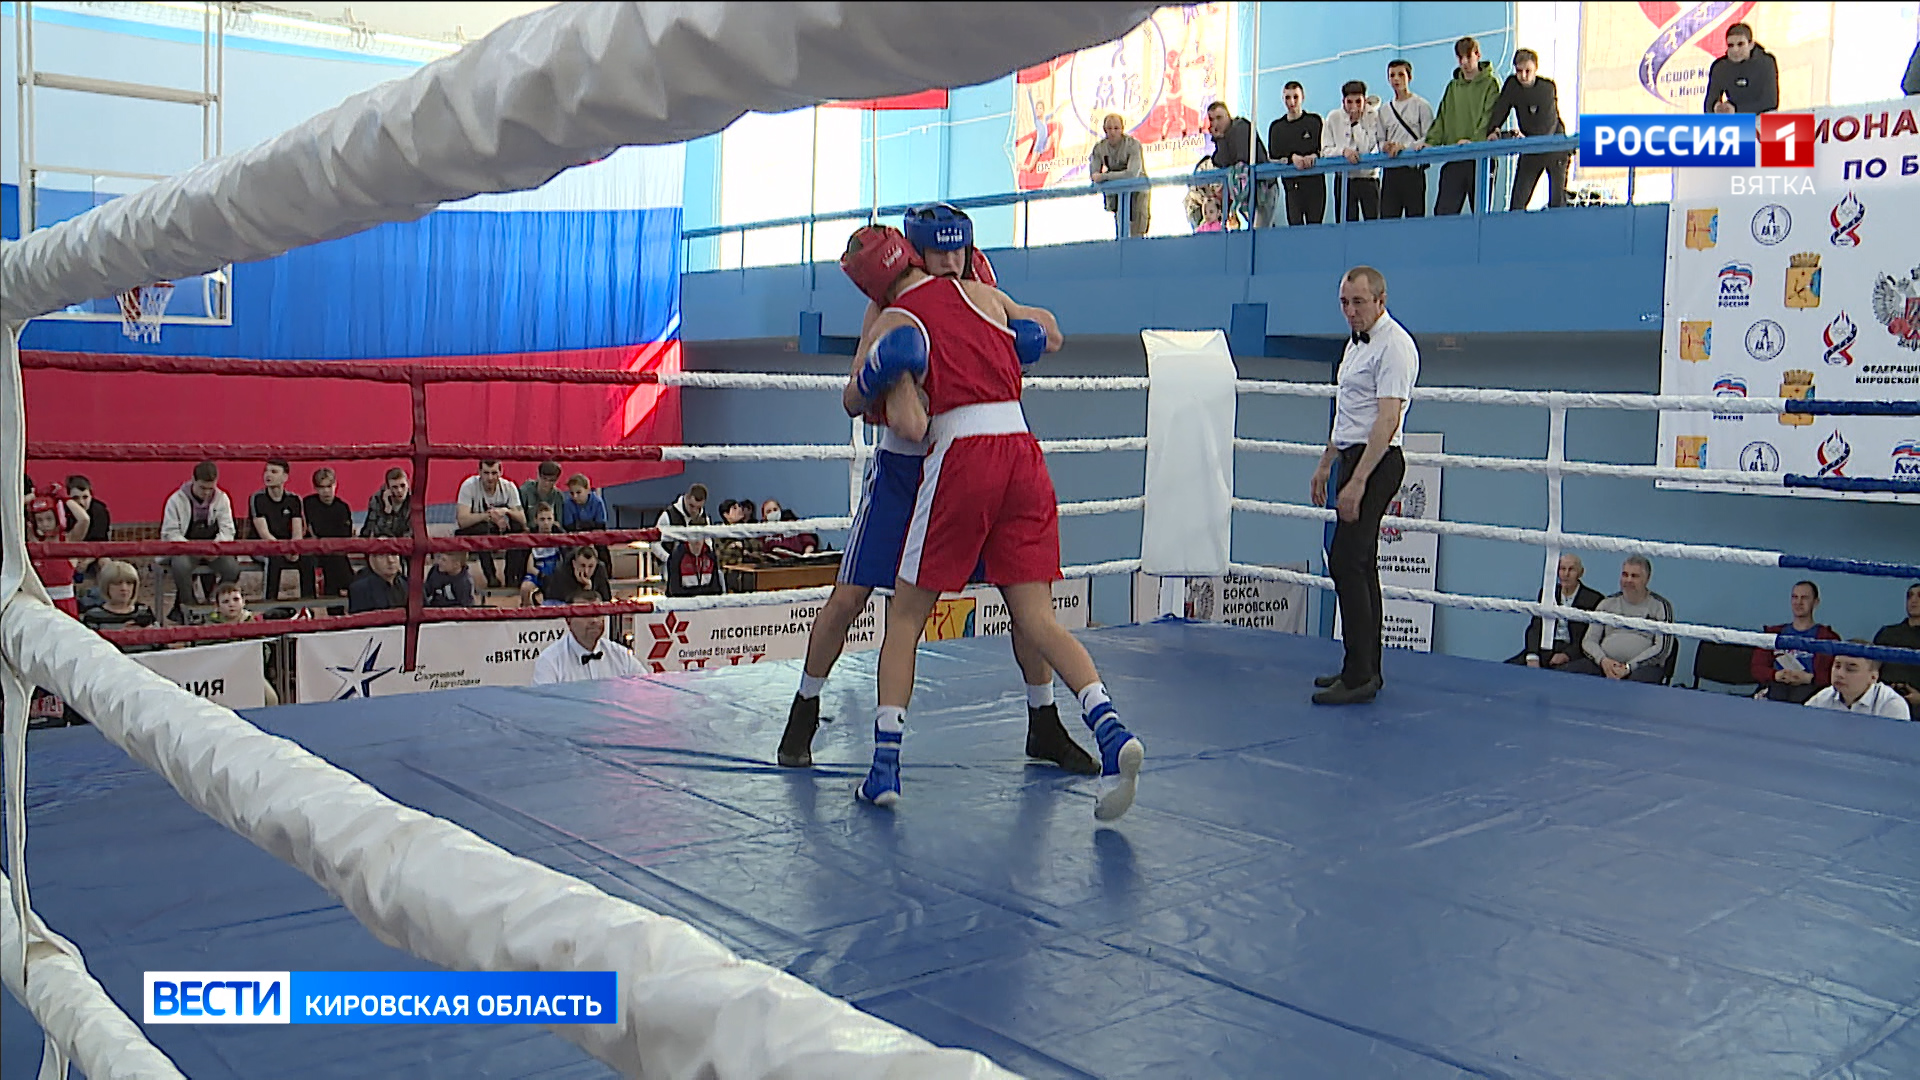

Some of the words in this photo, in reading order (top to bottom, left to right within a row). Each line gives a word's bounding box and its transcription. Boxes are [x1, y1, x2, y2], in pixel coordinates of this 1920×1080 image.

[1844, 157, 1887, 180] ПО
[1223, 587, 1260, 600] БОКСА
[1222, 597, 1289, 615] КИРОВСКОЙ
